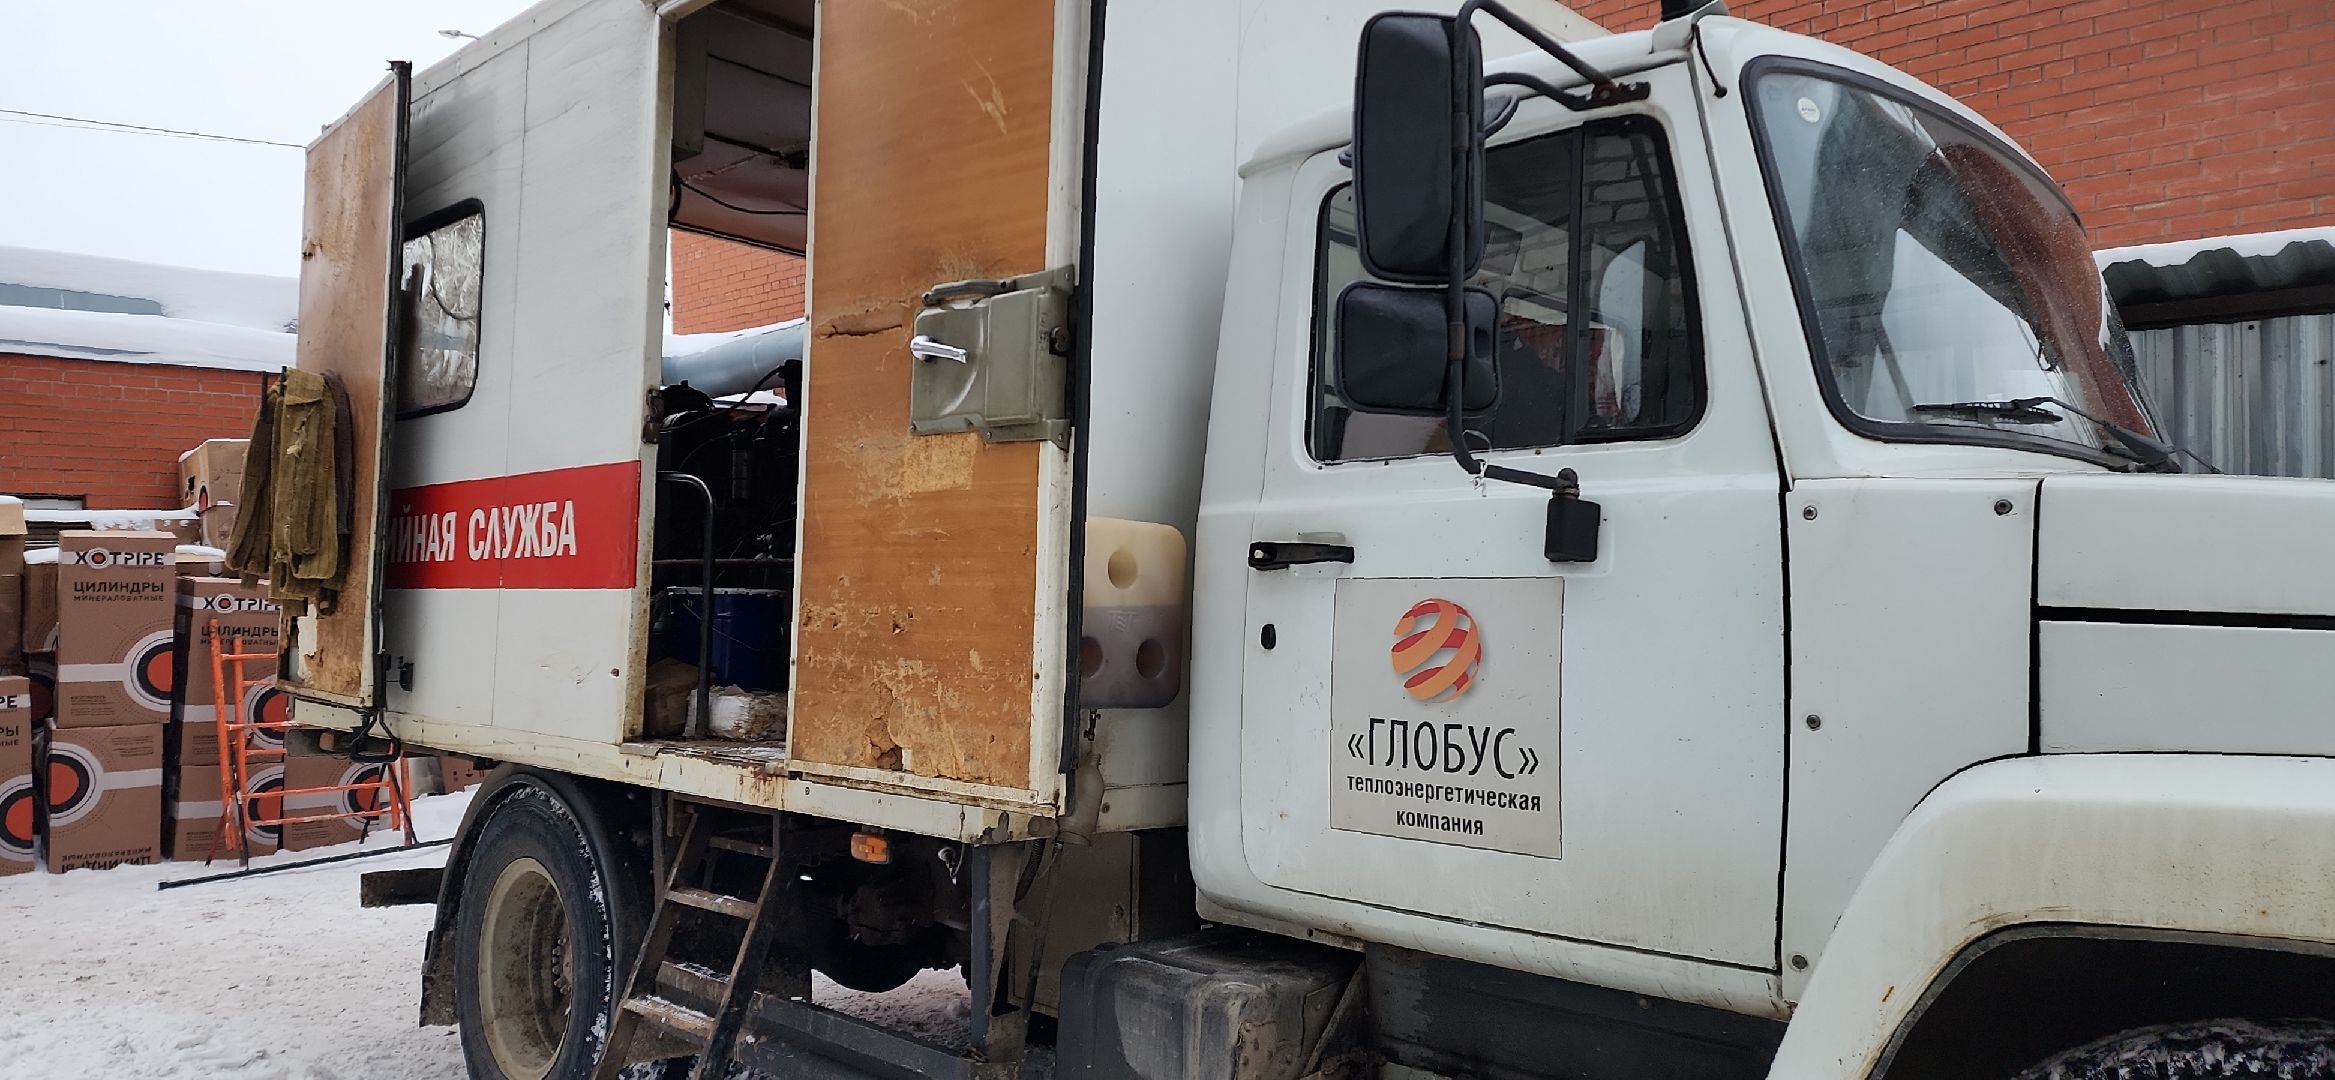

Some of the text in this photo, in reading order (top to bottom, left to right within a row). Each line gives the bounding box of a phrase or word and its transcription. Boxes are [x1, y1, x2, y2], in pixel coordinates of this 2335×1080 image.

[468, 500, 576, 561] СЛУЖБА
[73, 581, 165, 594] ЦИЛИНДРЫ
[73, 594, 165, 602] МИНЕРАЛОВАТНЫЕ
[1347, 717, 1540, 780] «ГЛОБУС»
[1347, 775, 1541, 812] теплоэнергетическая
[1396, 810, 1484, 836] компания
